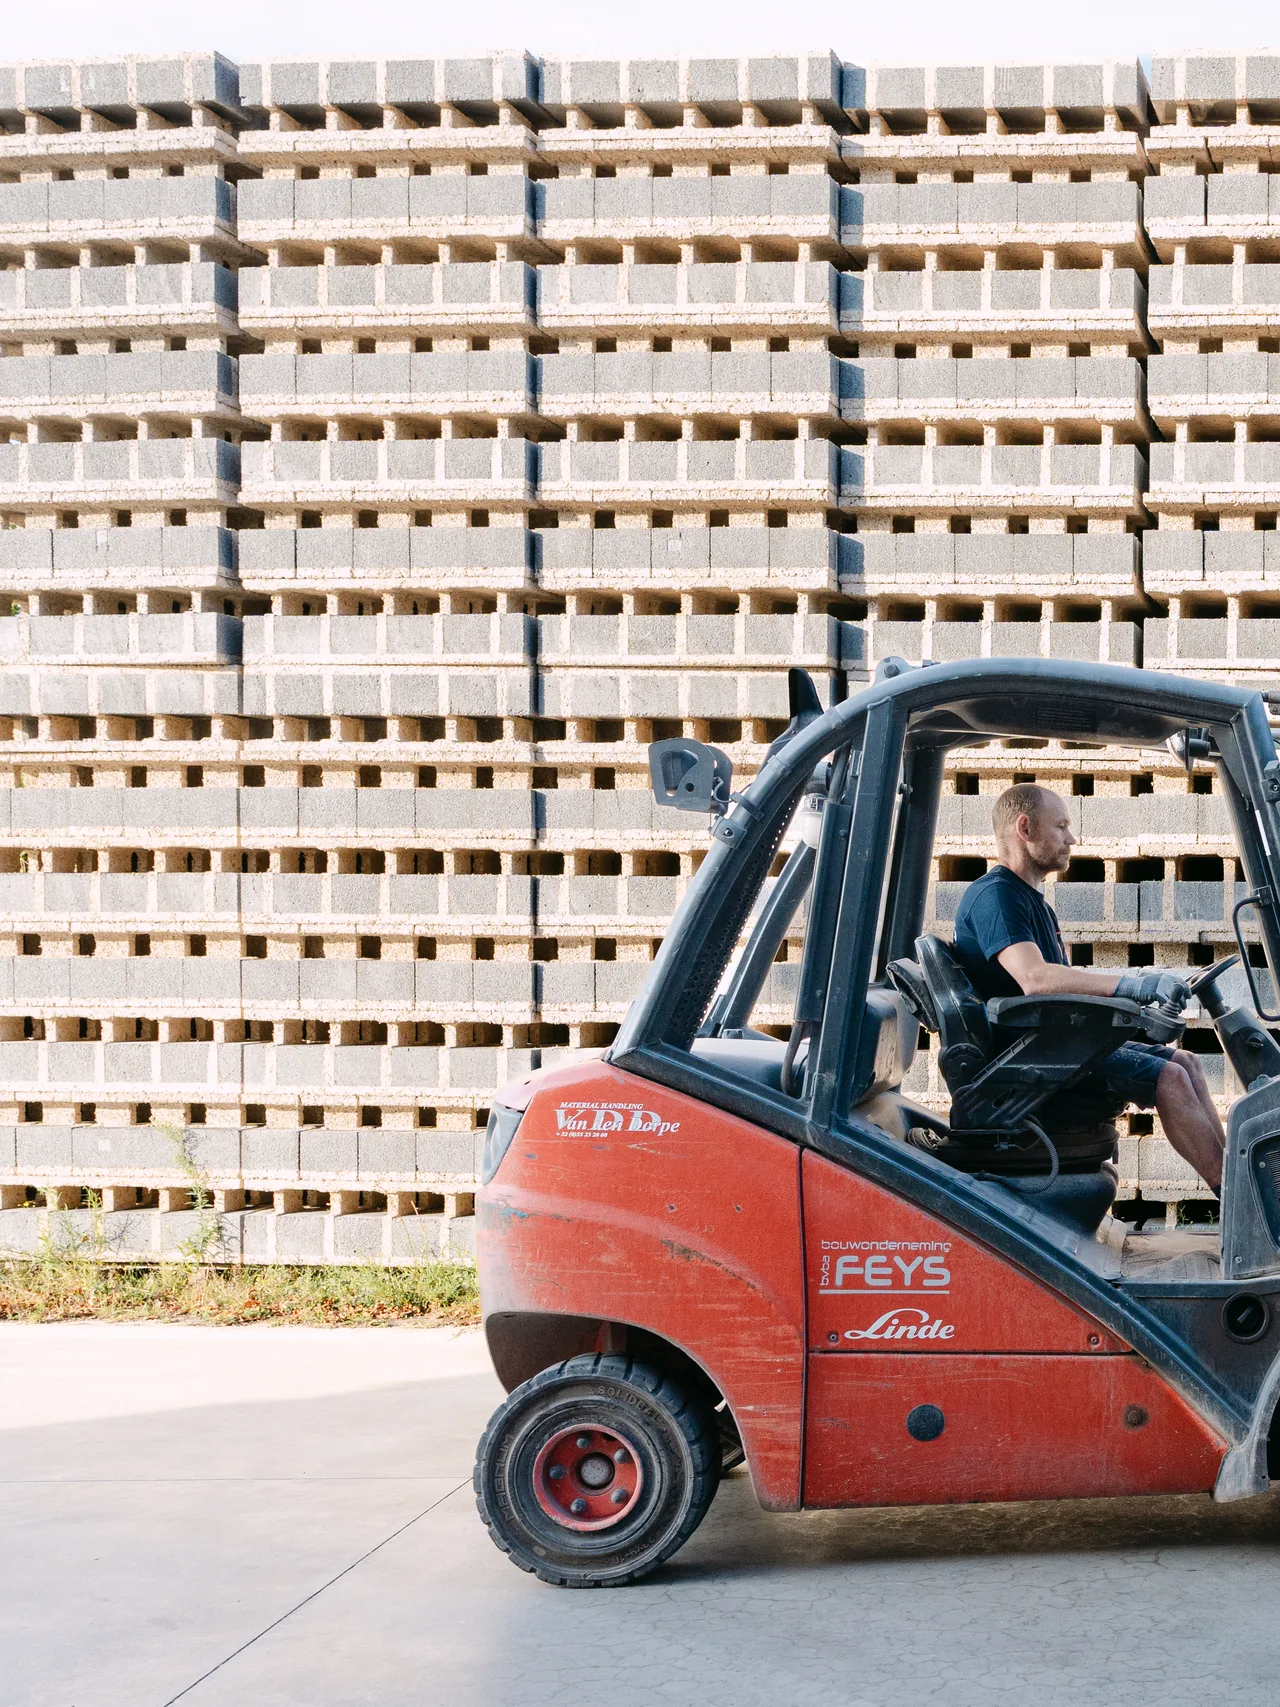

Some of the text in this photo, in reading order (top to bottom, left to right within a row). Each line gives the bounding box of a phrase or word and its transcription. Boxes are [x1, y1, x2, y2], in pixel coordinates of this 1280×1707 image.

[625, 1110, 680, 1137] Dorpe
[821, 1239, 952, 1252] bouwonderneming
[820, 1255, 830, 1286] bvba
[835, 1255, 951, 1286] FEYS
[844, 1307, 955, 1340] Linde
[494, 1433, 515, 1522] MAGNUM
